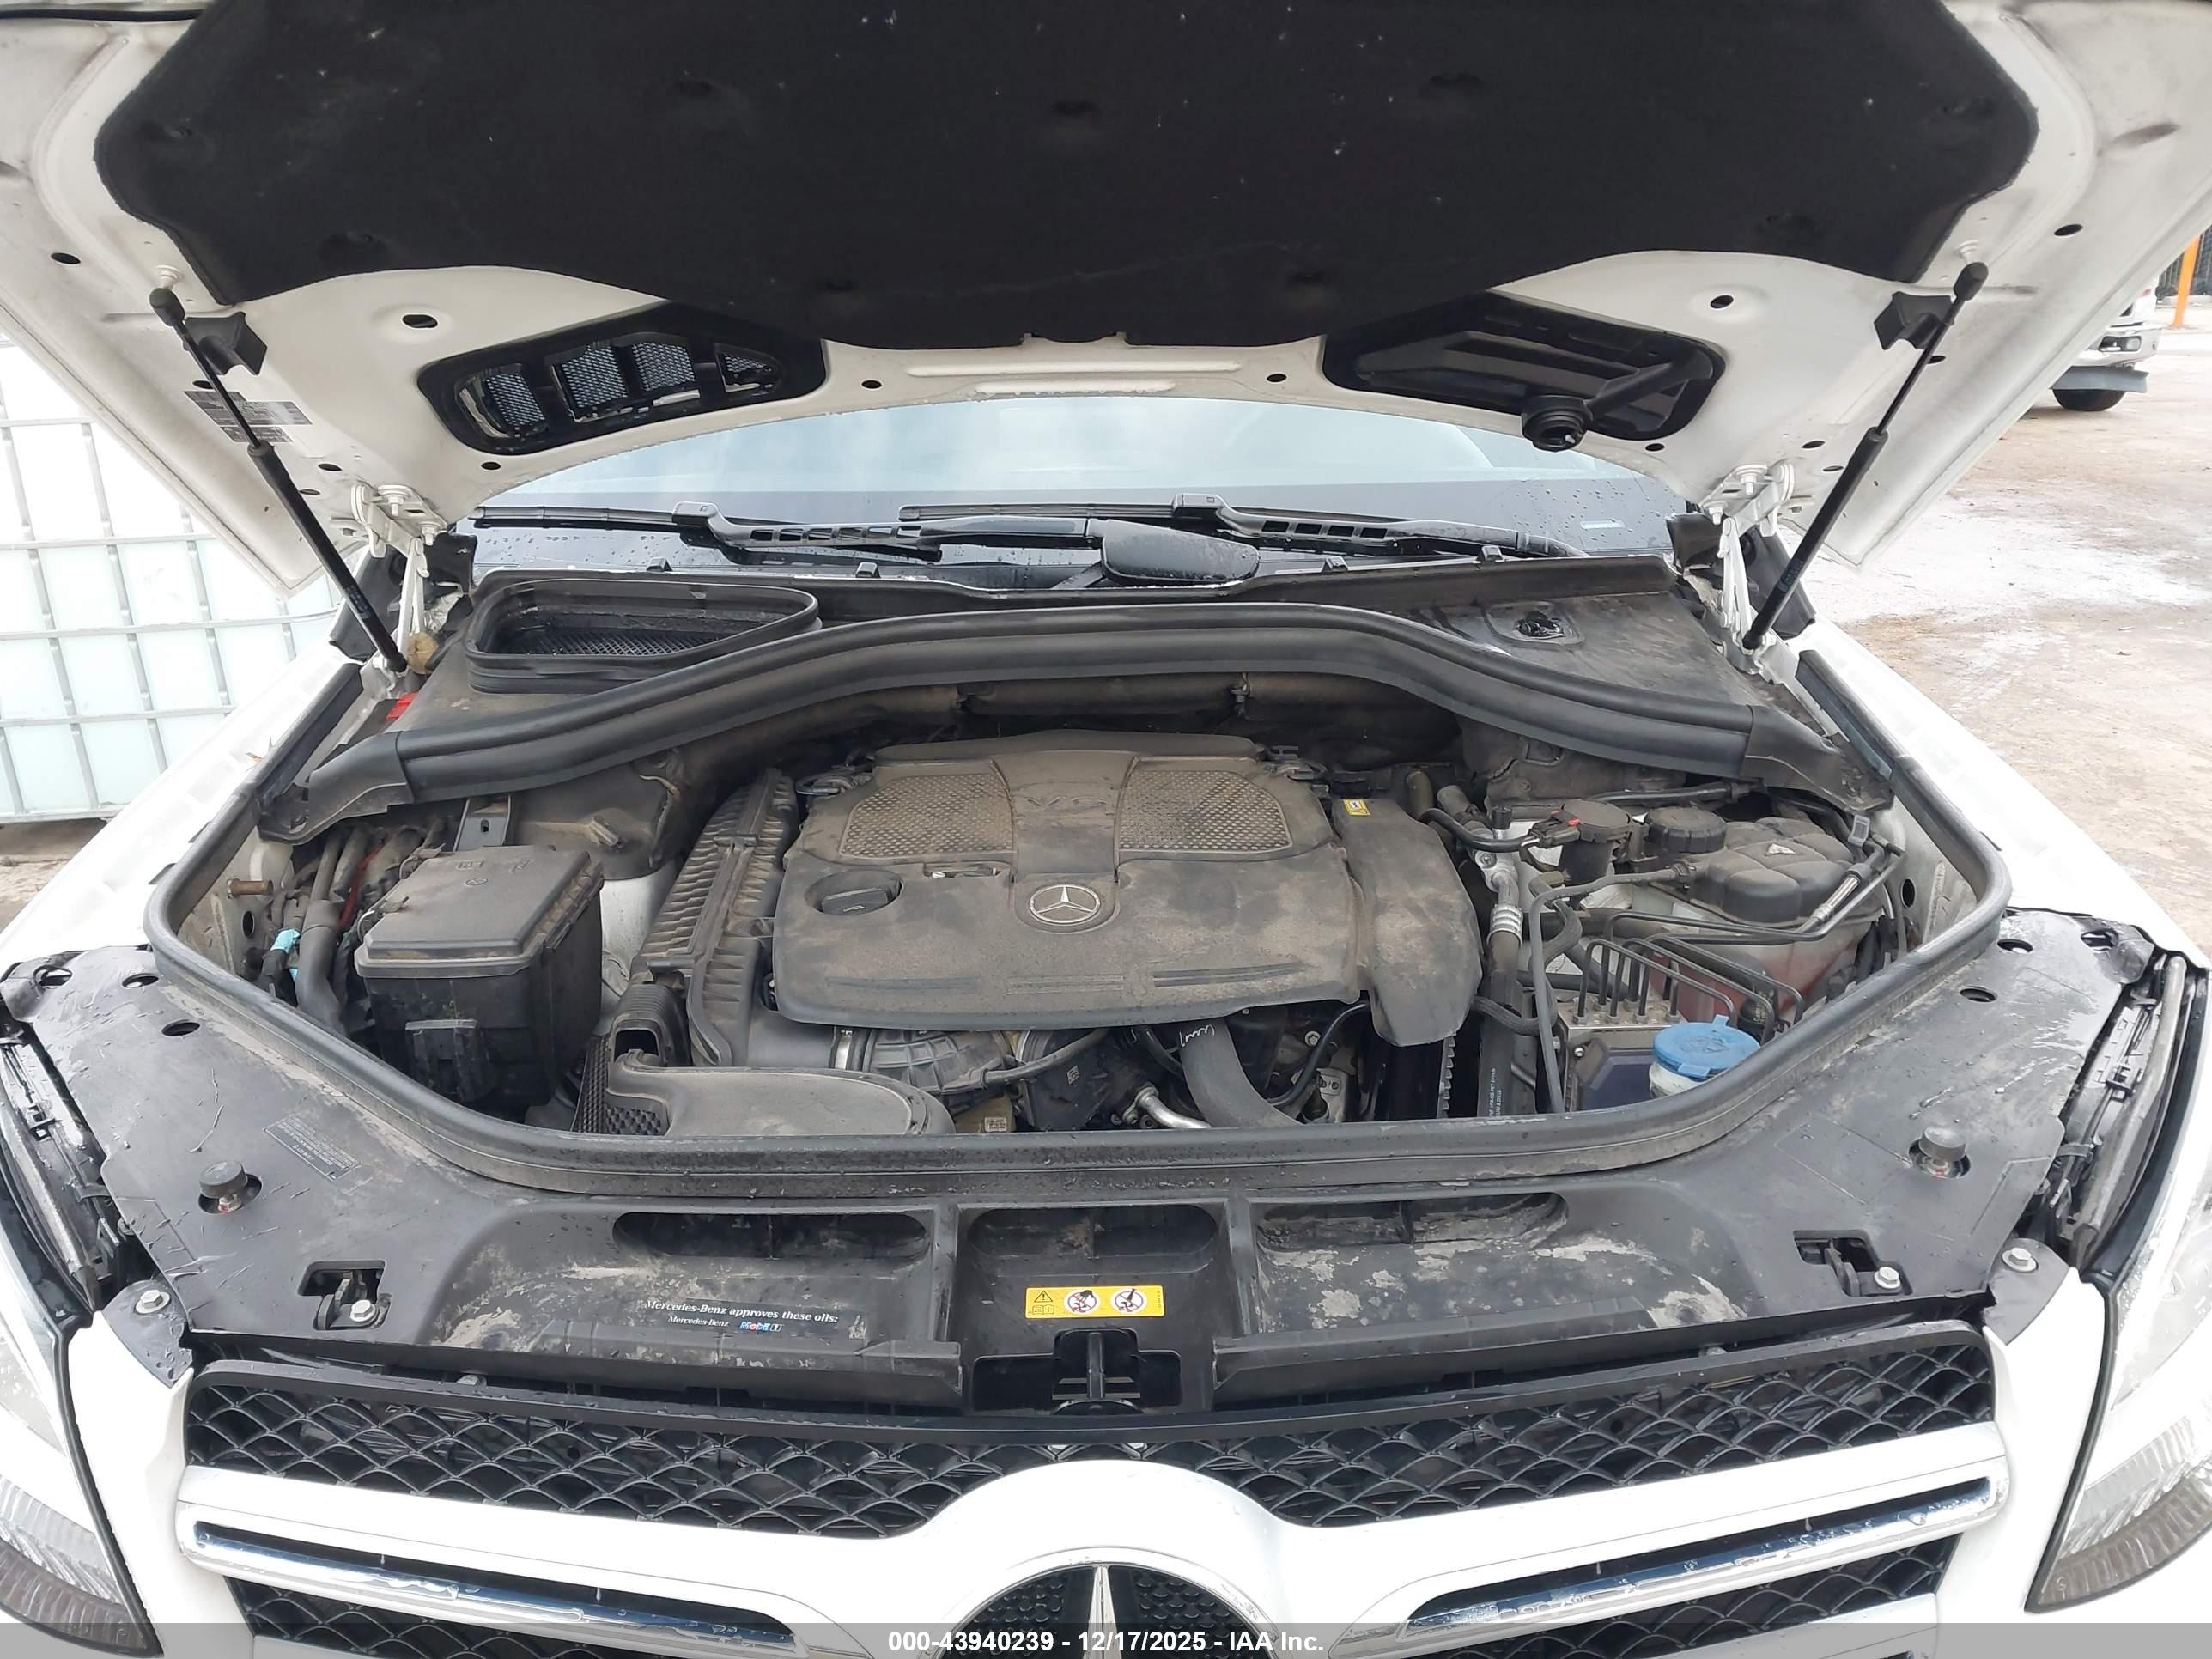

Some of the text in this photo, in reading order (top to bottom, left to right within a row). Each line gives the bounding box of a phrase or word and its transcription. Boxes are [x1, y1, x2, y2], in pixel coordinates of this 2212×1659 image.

[644, 1300, 839, 1323] Mercedes-Benz approves these oils:
[667, 1316, 730, 1328] Mercedes-Benz
[739, 1322, 770, 1332] Mobil
